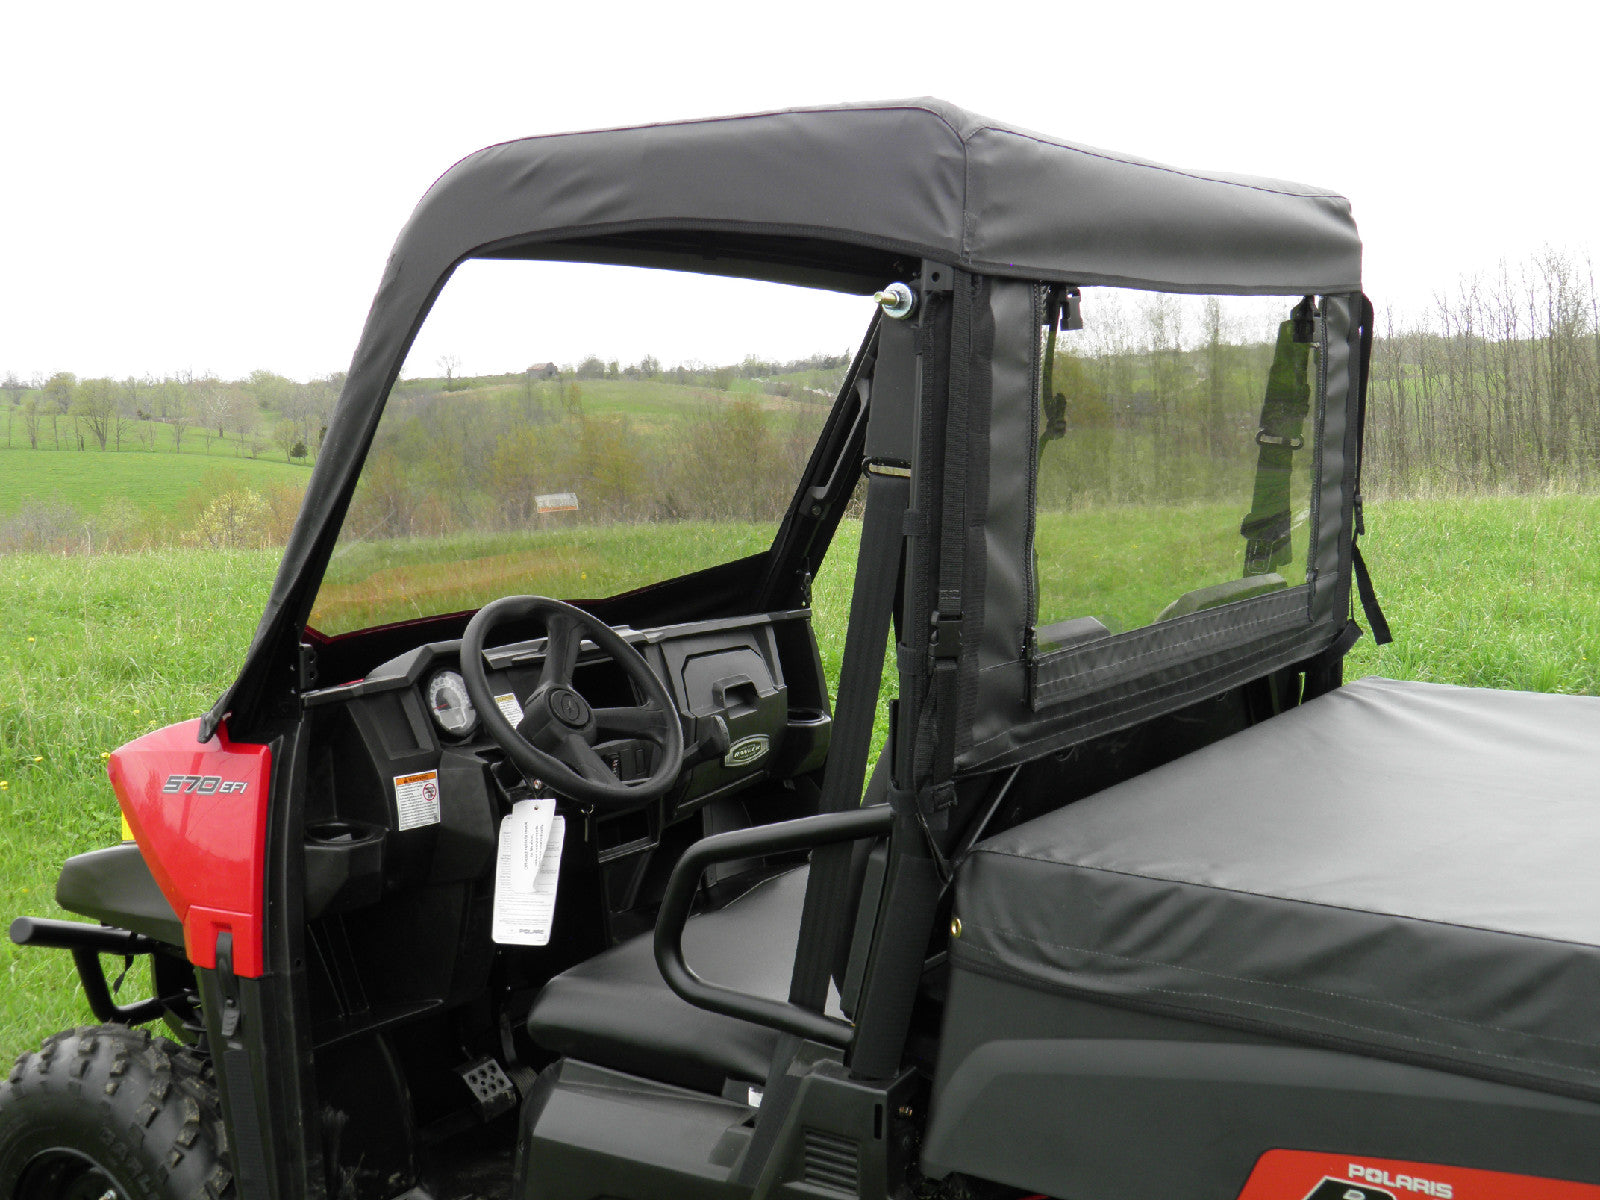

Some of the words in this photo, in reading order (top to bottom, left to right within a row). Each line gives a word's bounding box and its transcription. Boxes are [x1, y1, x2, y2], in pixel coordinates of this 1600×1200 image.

[162, 774, 222, 796] 570
[219, 781, 248, 794] EFI
[1348, 1163, 1454, 1199] POLARIS
